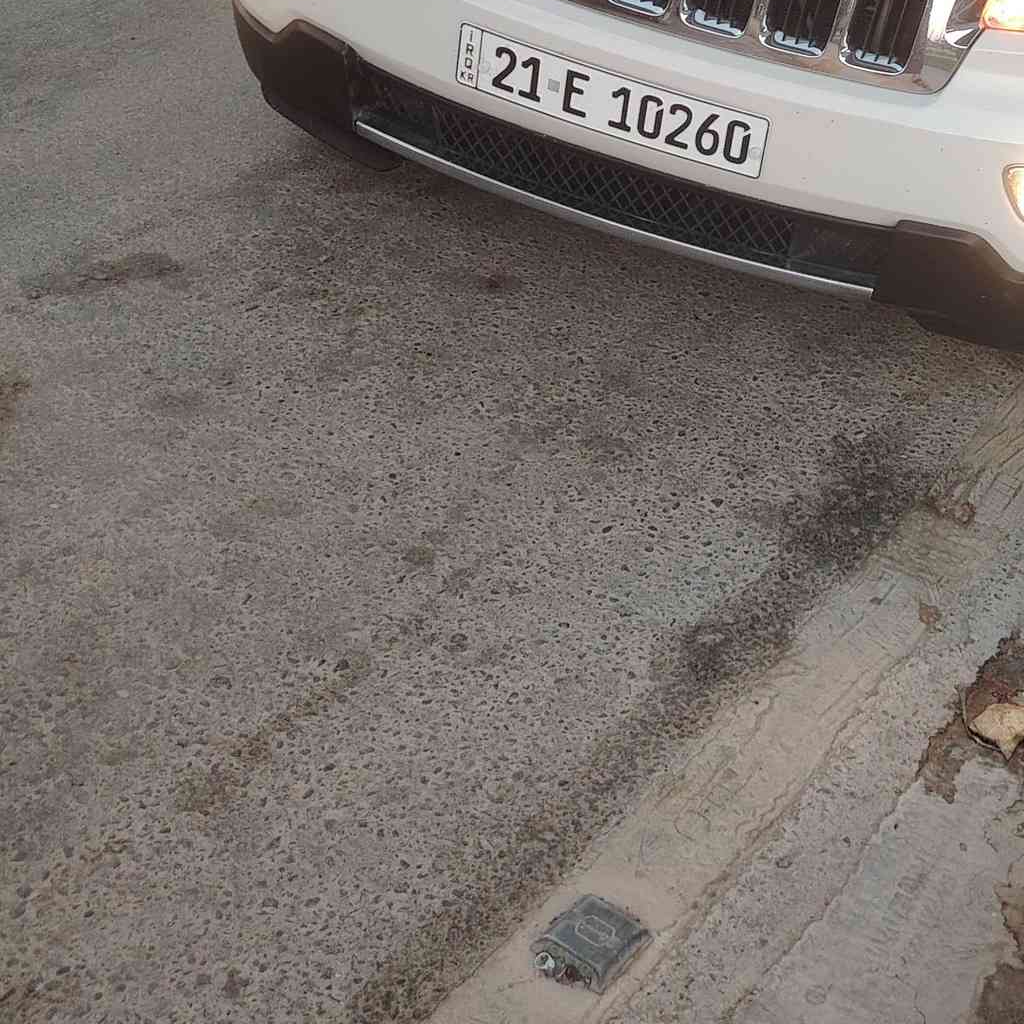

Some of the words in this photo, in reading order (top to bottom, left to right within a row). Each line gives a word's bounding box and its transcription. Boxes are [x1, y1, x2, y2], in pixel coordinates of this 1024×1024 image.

[491, 45, 541, 103] 21
[561, 68, 592, 118] E
[607, 86, 752, 165] 10260
